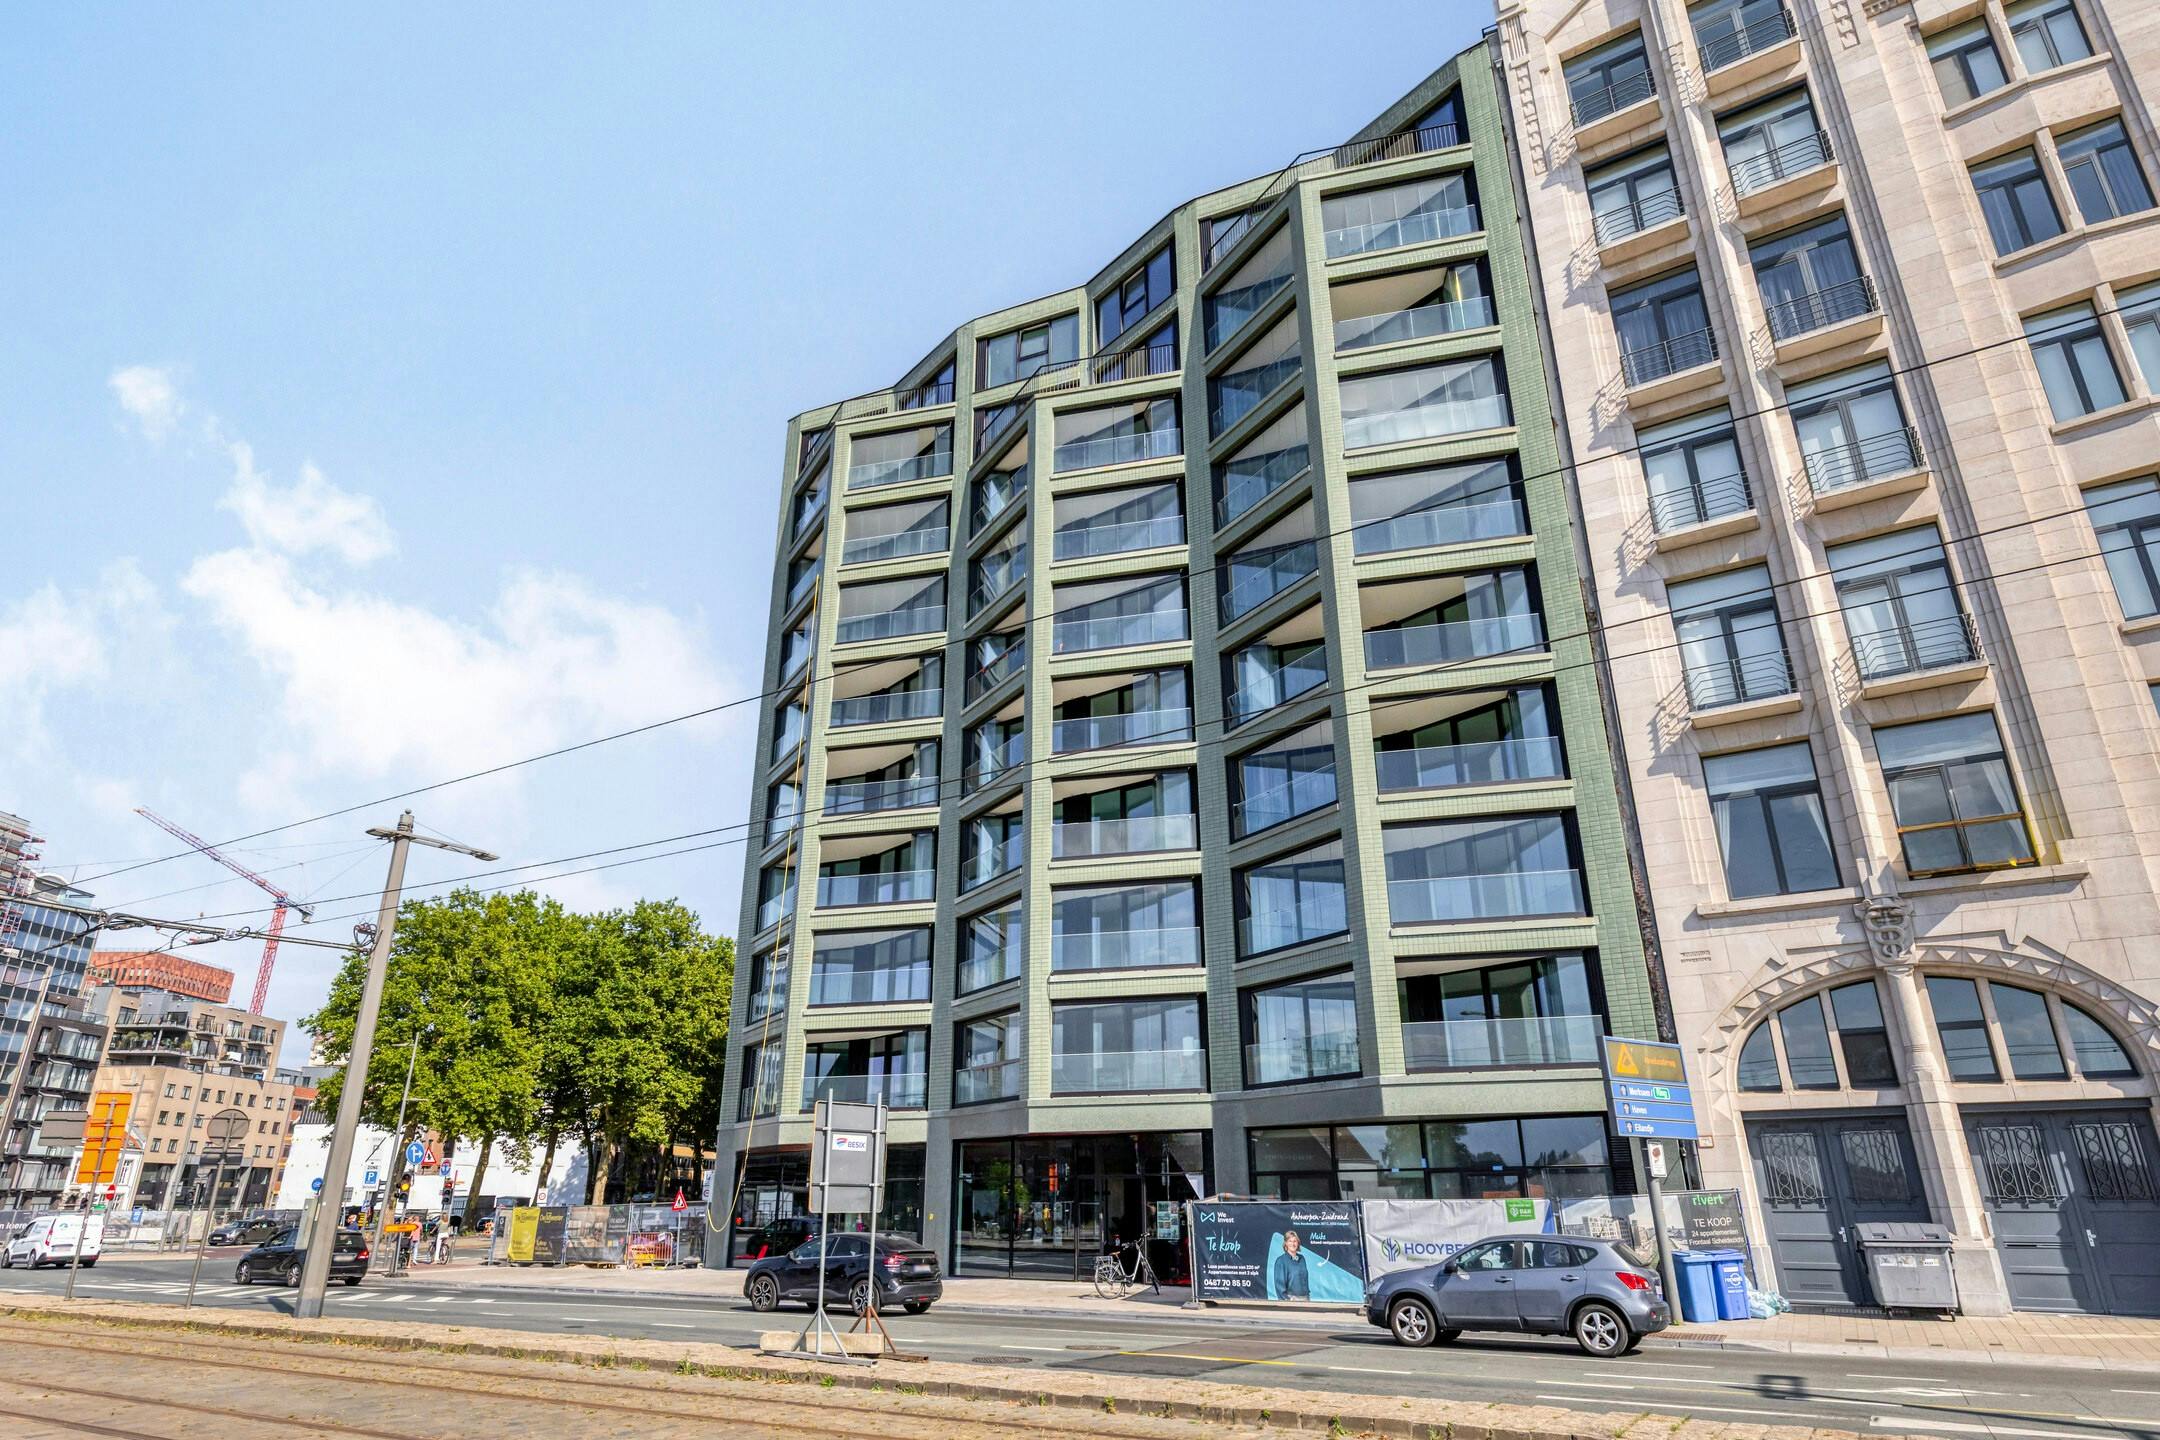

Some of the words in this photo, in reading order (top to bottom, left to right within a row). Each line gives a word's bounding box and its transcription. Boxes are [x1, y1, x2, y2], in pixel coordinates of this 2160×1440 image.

[1634, 1123, 1655, 1134] Eilandje
[847, 1140, 866, 1149] BESIX
[1693, 1218, 1706, 1228] TE
[1707, 1216, 1733, 1227] KOOP
[1691, 1230, 1699, 1238] 24
[1205, 1236, 1217, 1251] Te
[1219, 1228, 1241, 1254] koop
[1221, 1279, 1231, 1287] 70
[1242, 1279, 1251, 1287] 50
